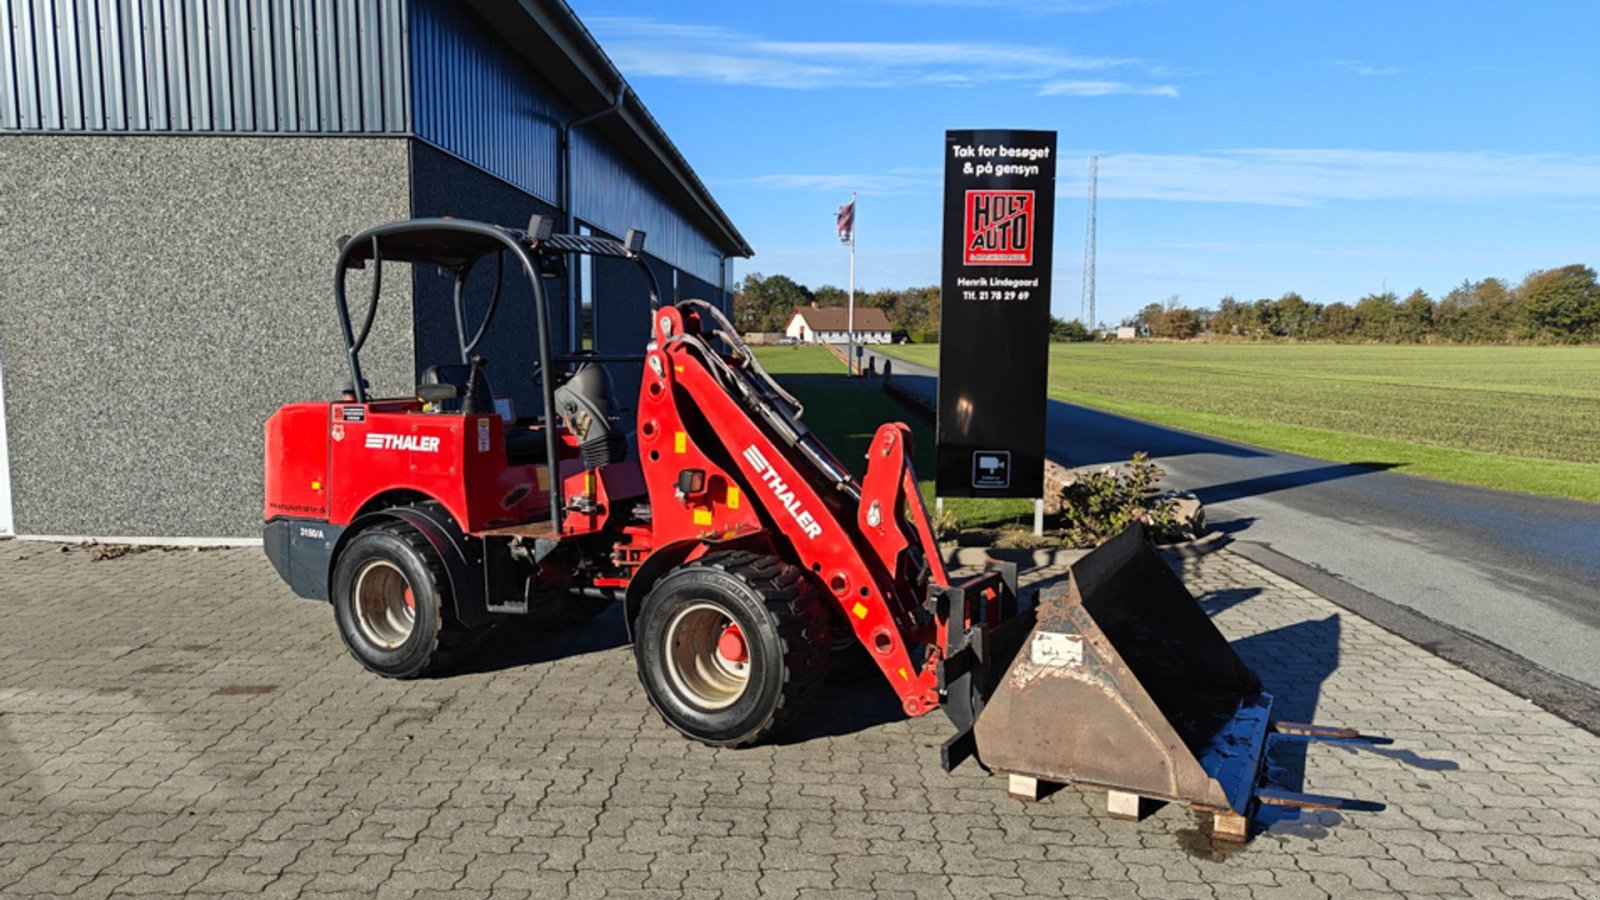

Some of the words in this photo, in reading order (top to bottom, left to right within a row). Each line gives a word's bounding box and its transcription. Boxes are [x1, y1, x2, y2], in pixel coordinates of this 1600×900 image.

[952, 146, 975, 158] Tak
[978, 145, 997, 158] for
[999, 145, 1050, 161] besøget
[962, 162, 974, 175] &
[976, 162, 993, 177] på
[995, 165, 1039, 178] gensyn
[973, 195, 1029, 233] HOLT
[970, 212, 1027, 251] AUTO
[957, 277, 988, 287] Henrik
[989, 277, 1039, 289] Lindegaard
[978, 291, 989, 301] 21
[990, 291, 1003, 301] 78
[1003, 291, 1016, 301] 29
[1017, 291, 1030, 301] 69
